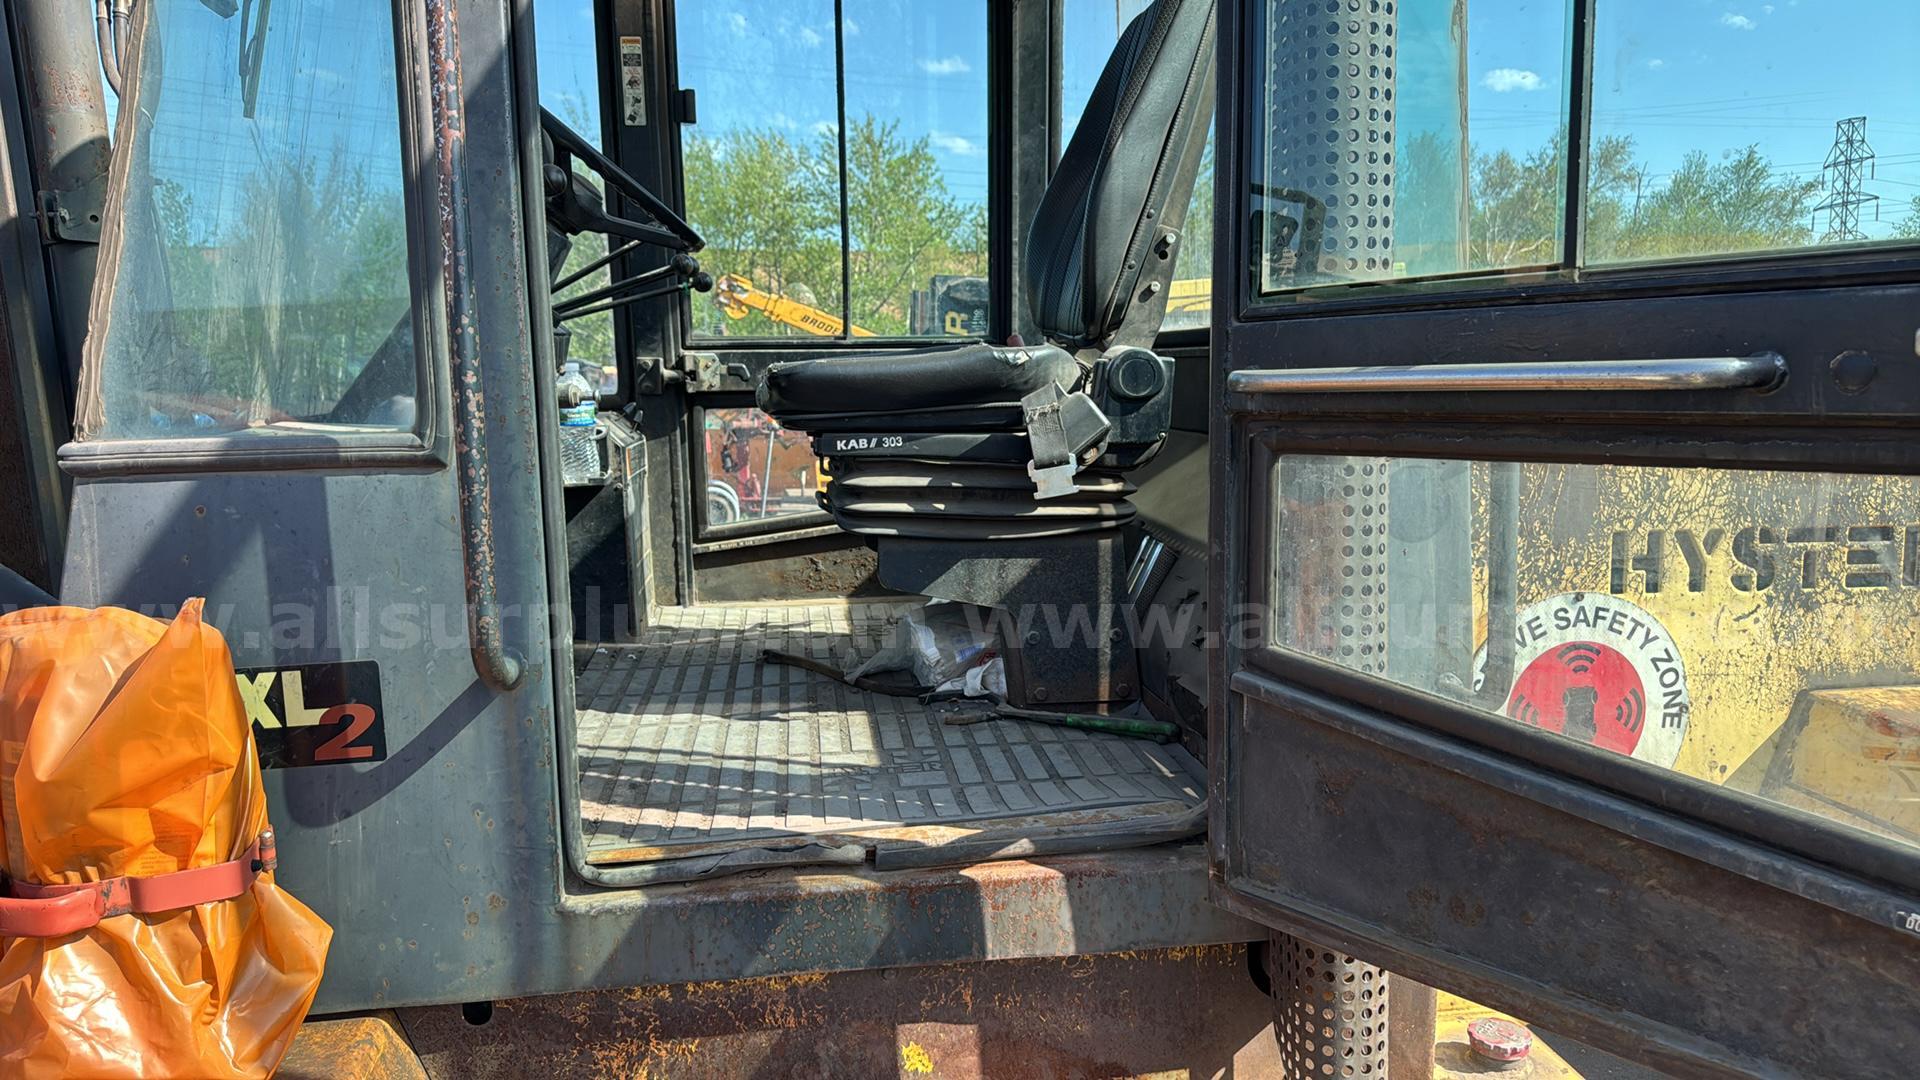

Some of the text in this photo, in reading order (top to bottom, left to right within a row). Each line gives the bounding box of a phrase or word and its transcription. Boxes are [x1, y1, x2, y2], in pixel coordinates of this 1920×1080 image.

[882, 436, 903, 448] 303
[1553, 605, 1659, 650] SAFETY
[1650, 647, 1684, 730] ZONE
